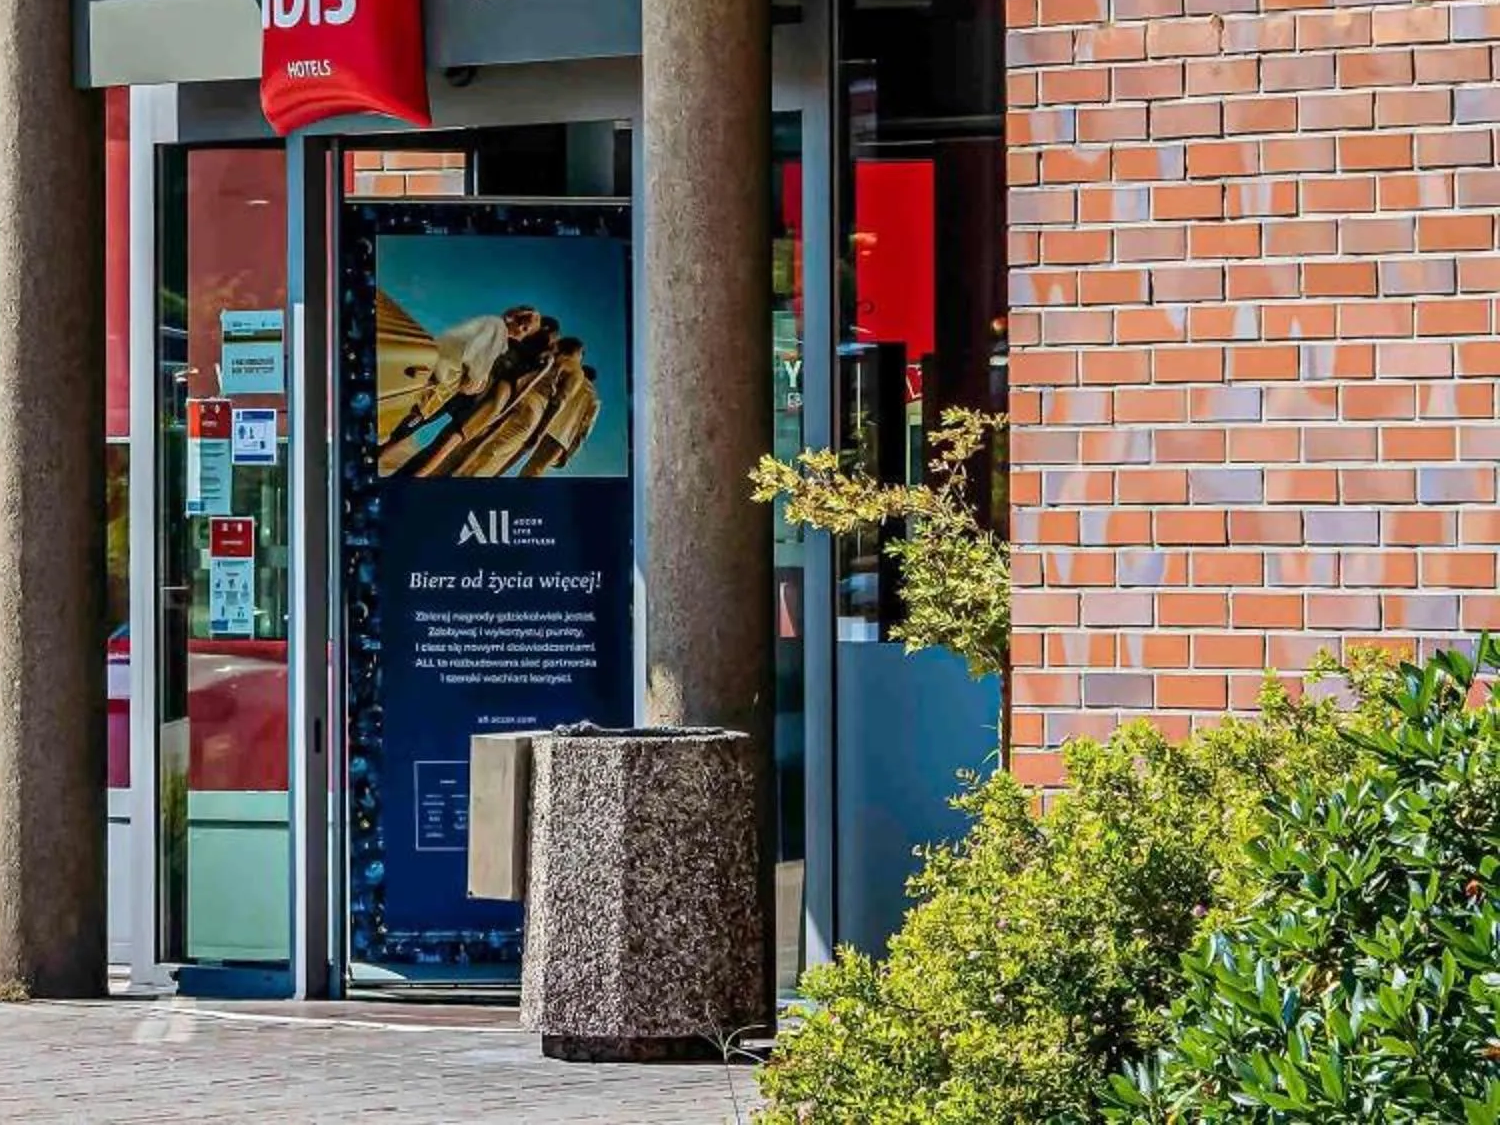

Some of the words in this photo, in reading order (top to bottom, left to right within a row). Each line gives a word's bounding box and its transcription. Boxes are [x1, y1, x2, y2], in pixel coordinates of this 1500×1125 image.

[287, 59, 331, 77] HOTELS
[409, 570, 455, 588] Bierz
[461, 567, 484, 588] od
[488, 571, 534, 594] życia
[539, 570, 602, 594] więcej!
